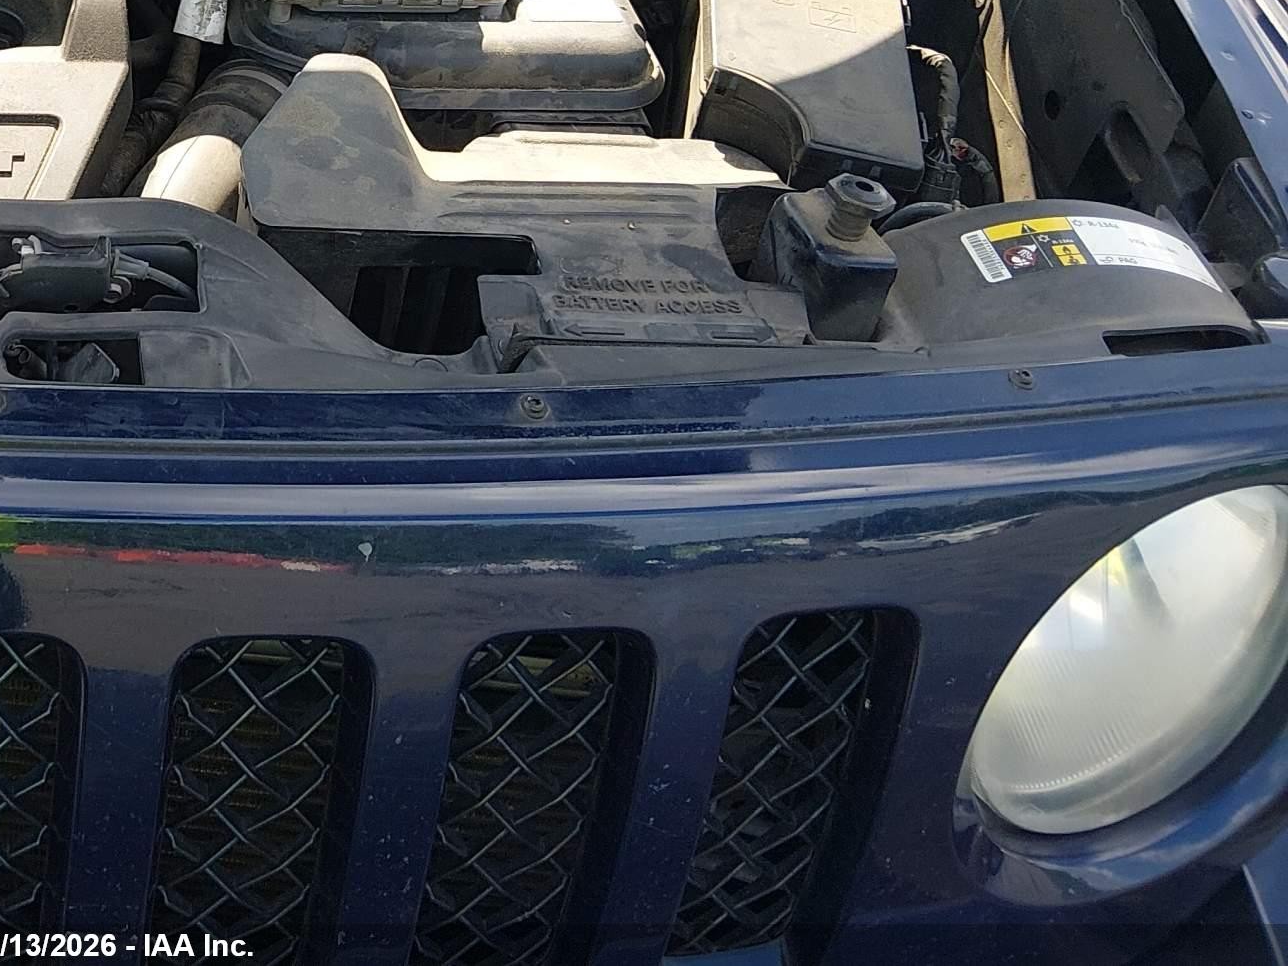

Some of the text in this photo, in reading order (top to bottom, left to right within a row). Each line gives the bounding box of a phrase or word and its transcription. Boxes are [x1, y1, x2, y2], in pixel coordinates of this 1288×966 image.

[563, 276, 710, 294] REMOVE FOR
[552, 294, 743, 315] BATTERY ACCESS
